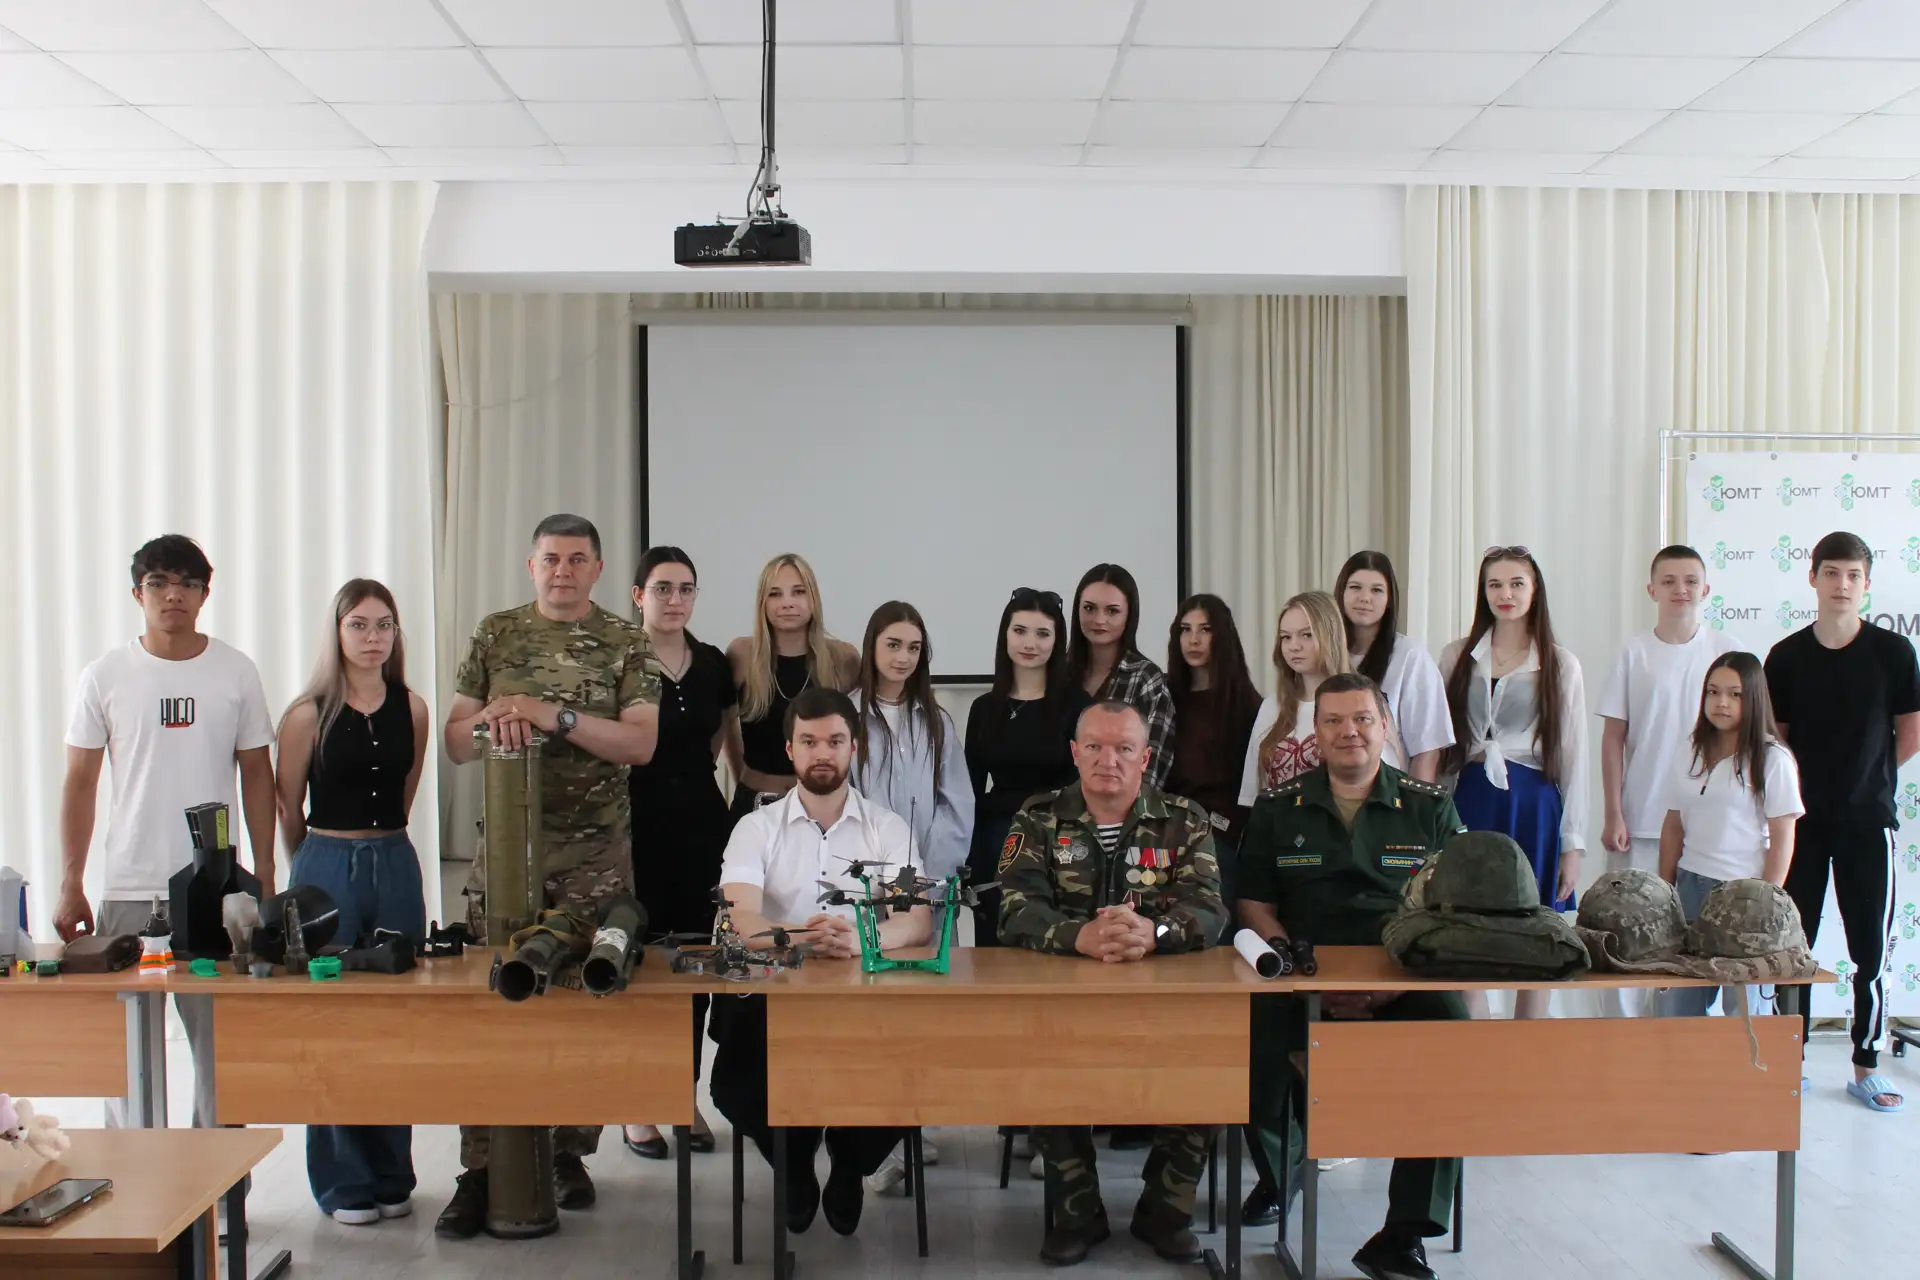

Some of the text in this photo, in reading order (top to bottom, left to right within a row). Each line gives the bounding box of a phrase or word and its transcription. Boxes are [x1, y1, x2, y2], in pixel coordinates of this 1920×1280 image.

[1720, 487, 1762, 499] ЮМТ
[1789, 487, 1821, 497] ЮМТ
[1850, 486, 1891, 498] ЮМТ
[1723, 550, 1755, 560] ЮМТ
[1788, 547, 1811, 560] ЮМ
[1720, 608, 1762, 620] ЮМТ
[1788, 610, 1818, 620] ЮМТ
[160, 697, 195, 726] HUGO
